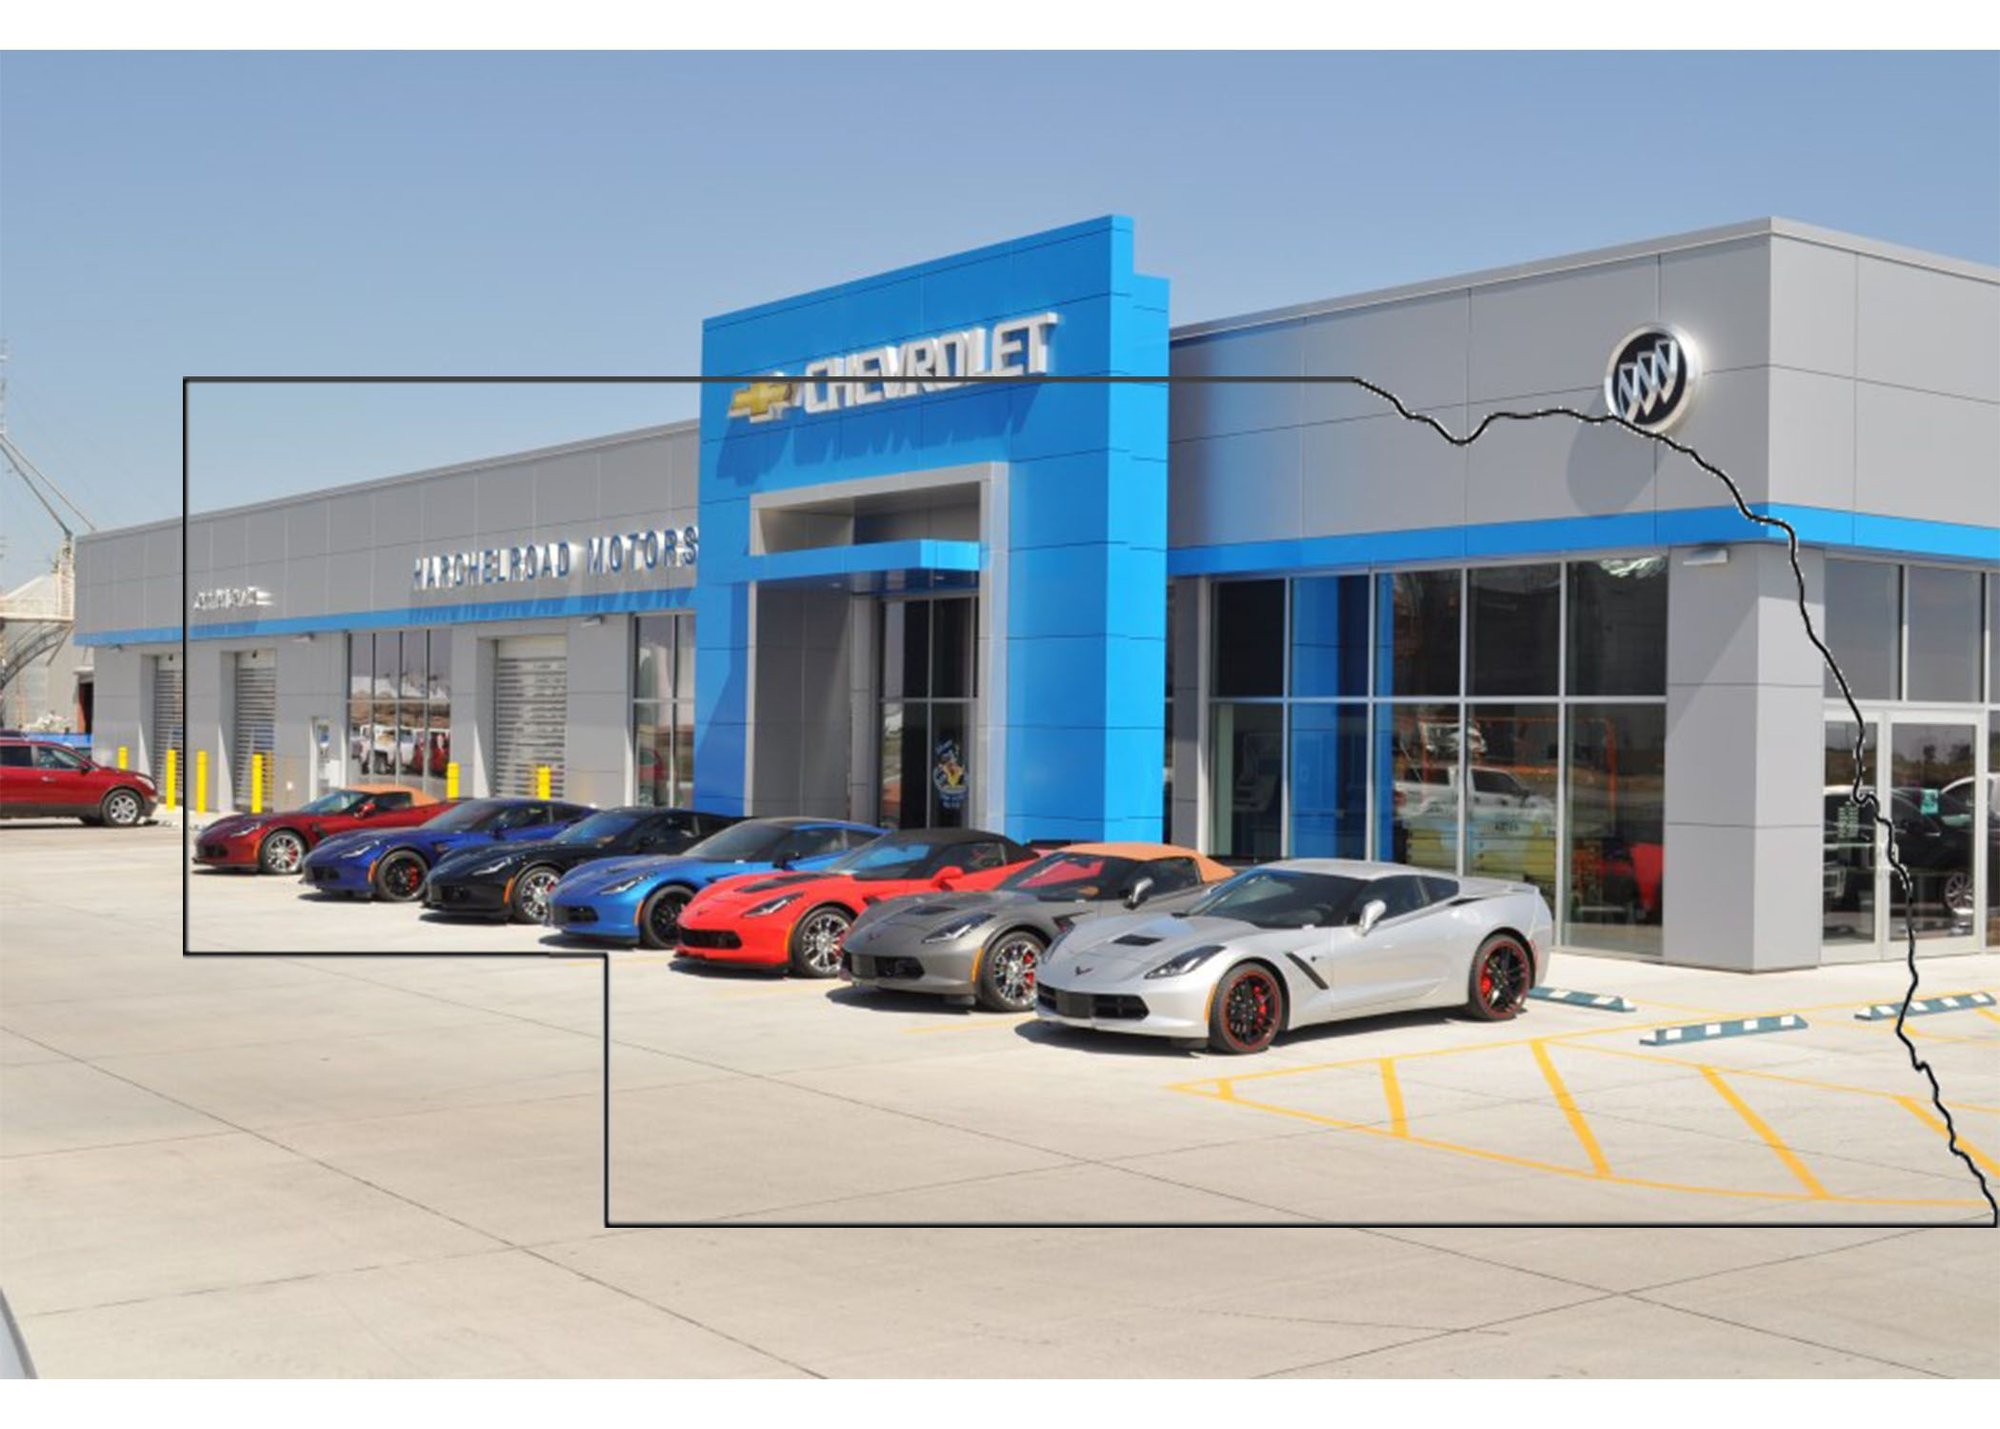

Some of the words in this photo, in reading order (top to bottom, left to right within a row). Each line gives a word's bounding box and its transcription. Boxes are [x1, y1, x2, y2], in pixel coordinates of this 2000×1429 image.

[804, 311, 1060, 415] CHEVROLET
[413, 541, 571, 590] HARCHELROAD
[587, 525, 698, 576] MOTORS
